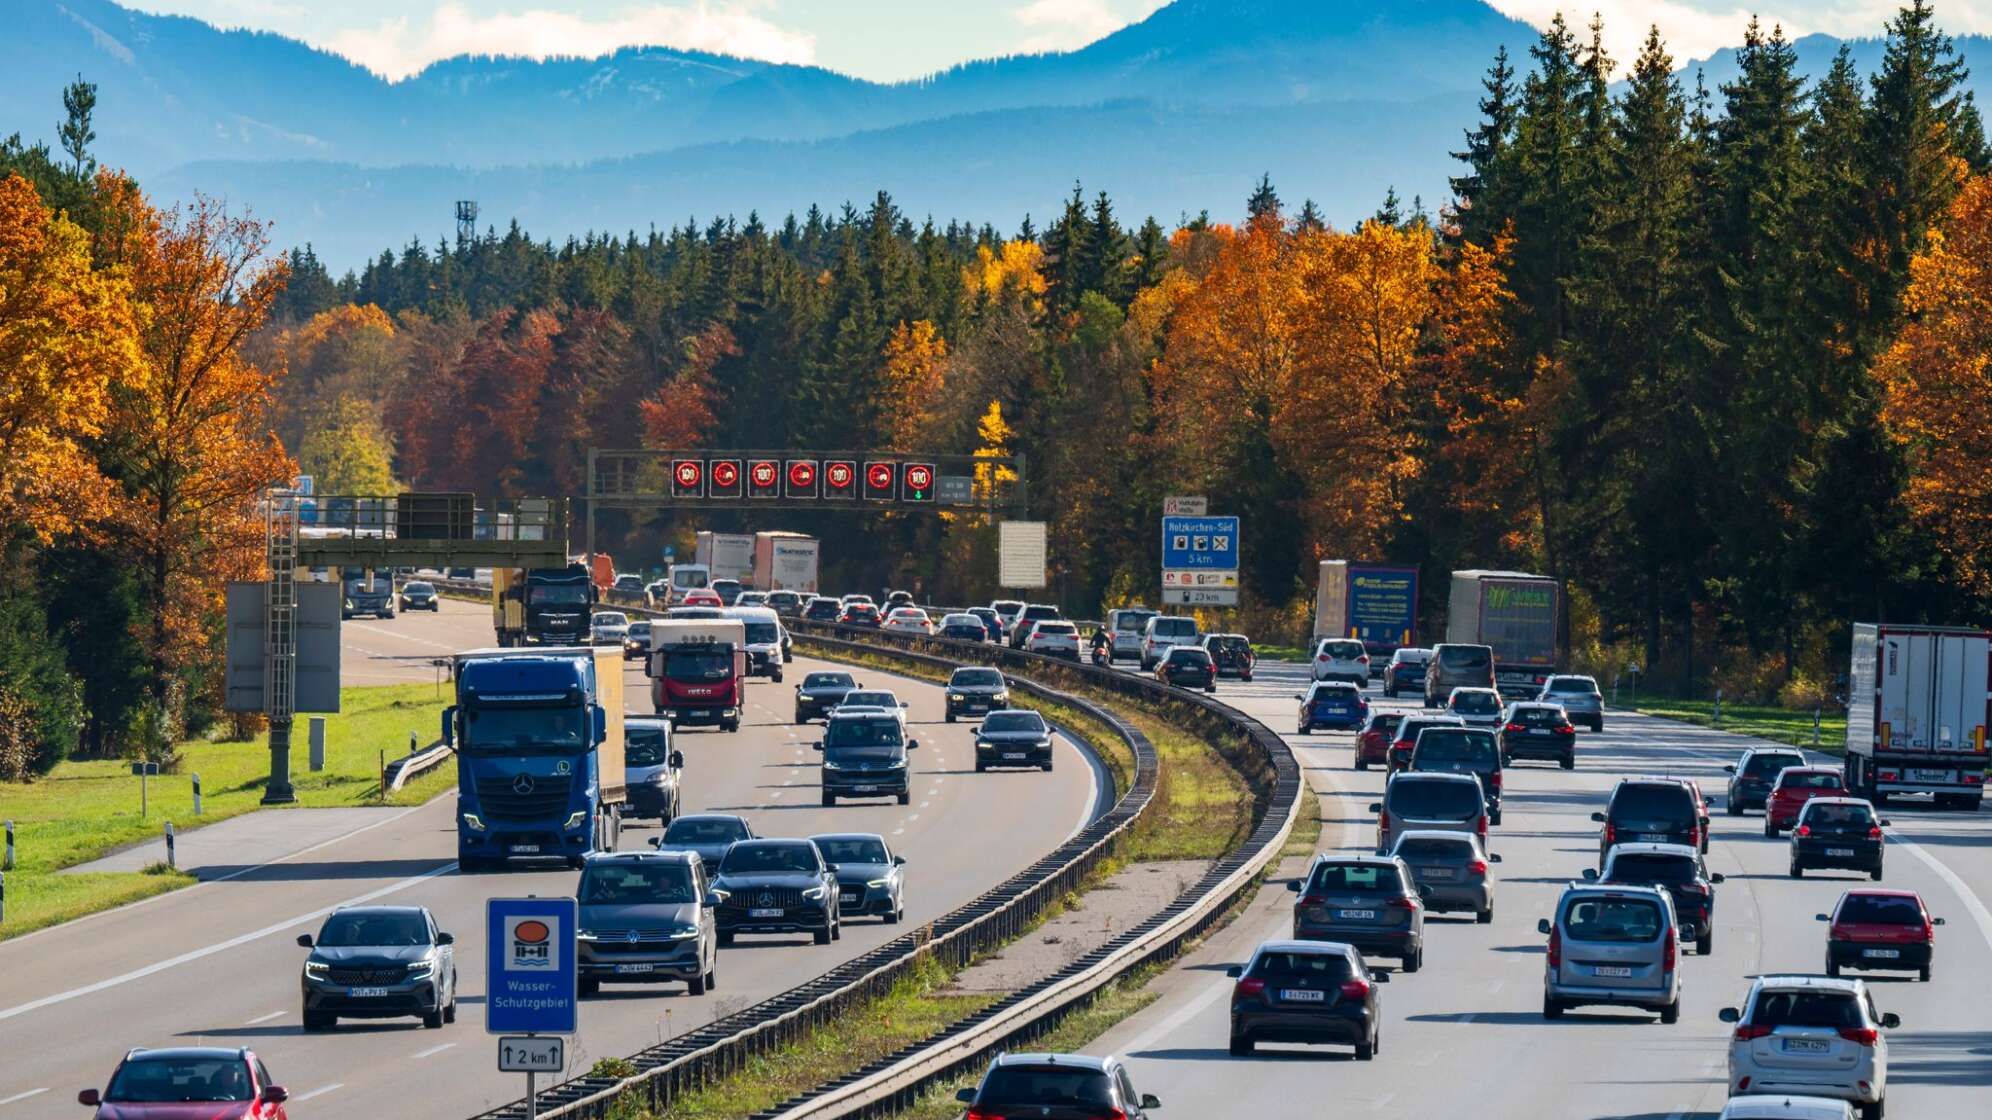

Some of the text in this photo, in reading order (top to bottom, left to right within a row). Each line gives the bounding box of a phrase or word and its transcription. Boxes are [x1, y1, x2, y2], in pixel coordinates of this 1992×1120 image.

[911, 471, 926, 484] 100
[1188, 554, 1213, 564] 5 km
[1206, 592, 1220, 601] km
[507, 980, 557, 992] Wasser-
[495, 997, 569, 1011] Schutzgebiet
[517, 1050, 548, 1064] 2 km
